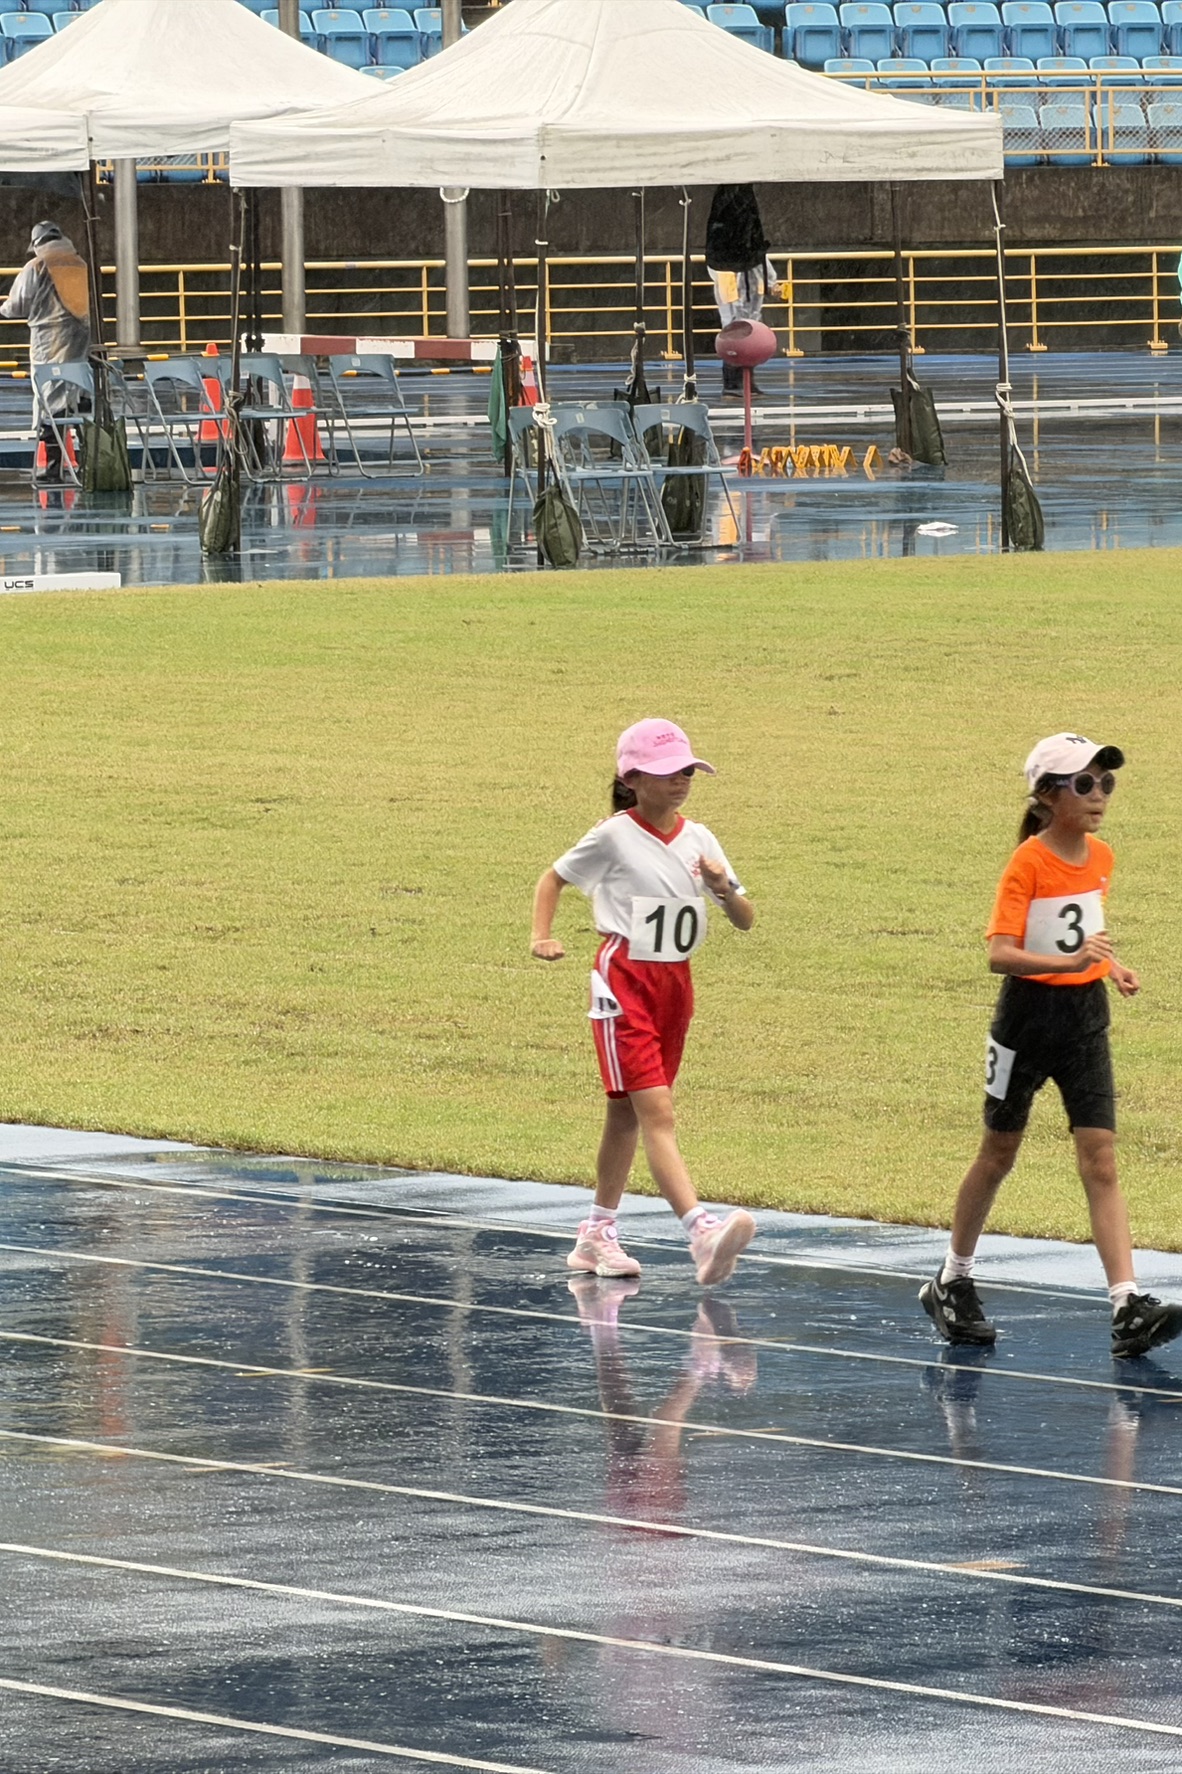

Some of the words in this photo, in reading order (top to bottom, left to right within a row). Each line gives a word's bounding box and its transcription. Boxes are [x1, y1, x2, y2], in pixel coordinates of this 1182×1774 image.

[4, 580, 34, 589] UCS
[645, 905, 698, 953] 10
[1055, 903, 1085, 954] 3
[986, 1046, 998, 1086] 3
